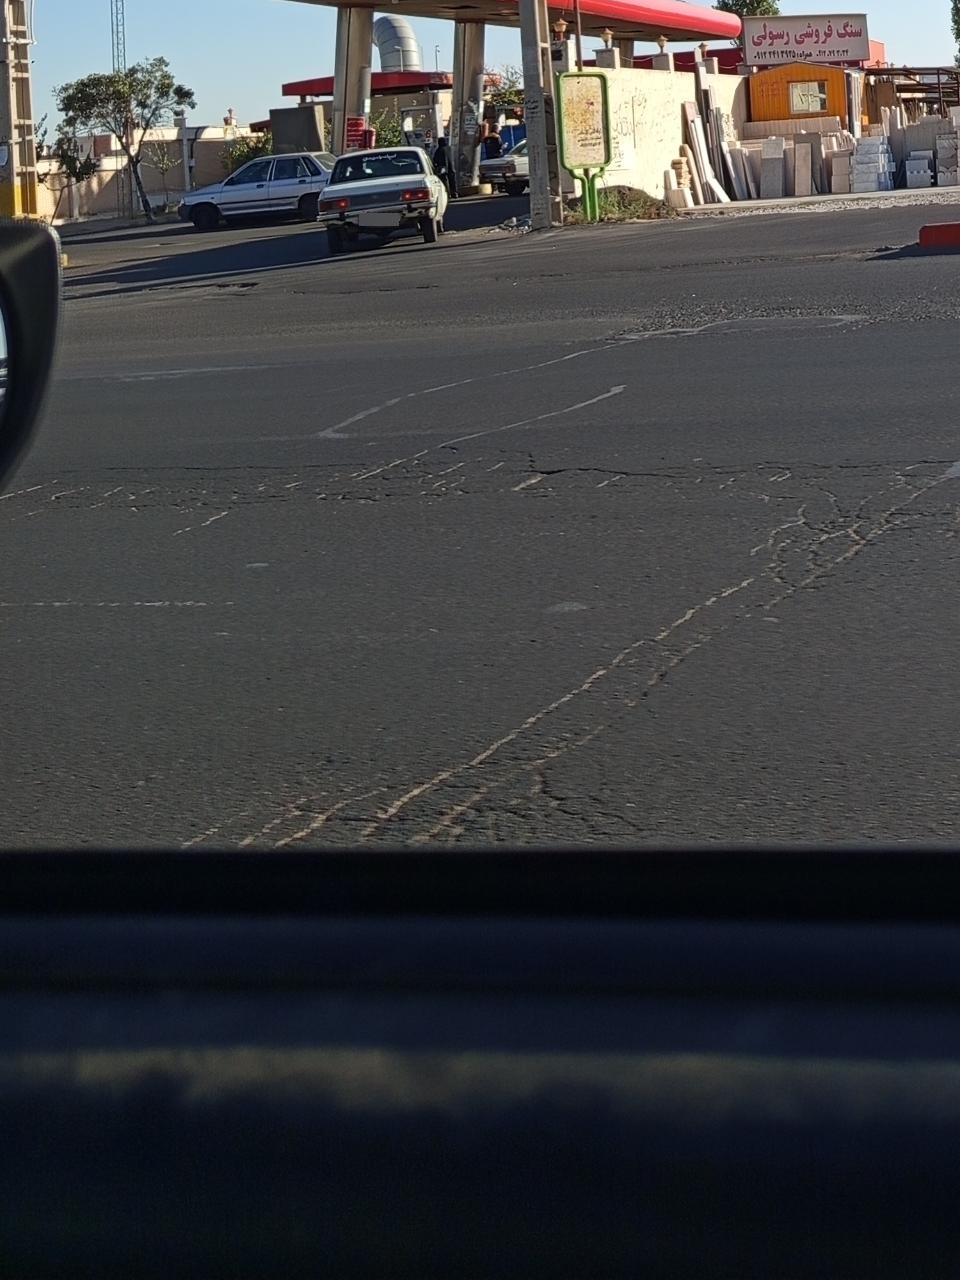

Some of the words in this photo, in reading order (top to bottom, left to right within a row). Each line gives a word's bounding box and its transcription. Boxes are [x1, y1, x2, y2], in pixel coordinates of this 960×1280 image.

[751, 22, 790, 47] رسولی
[794, 20, 833, 45] فروشی
[836, 21, 862, 39] سنگ
